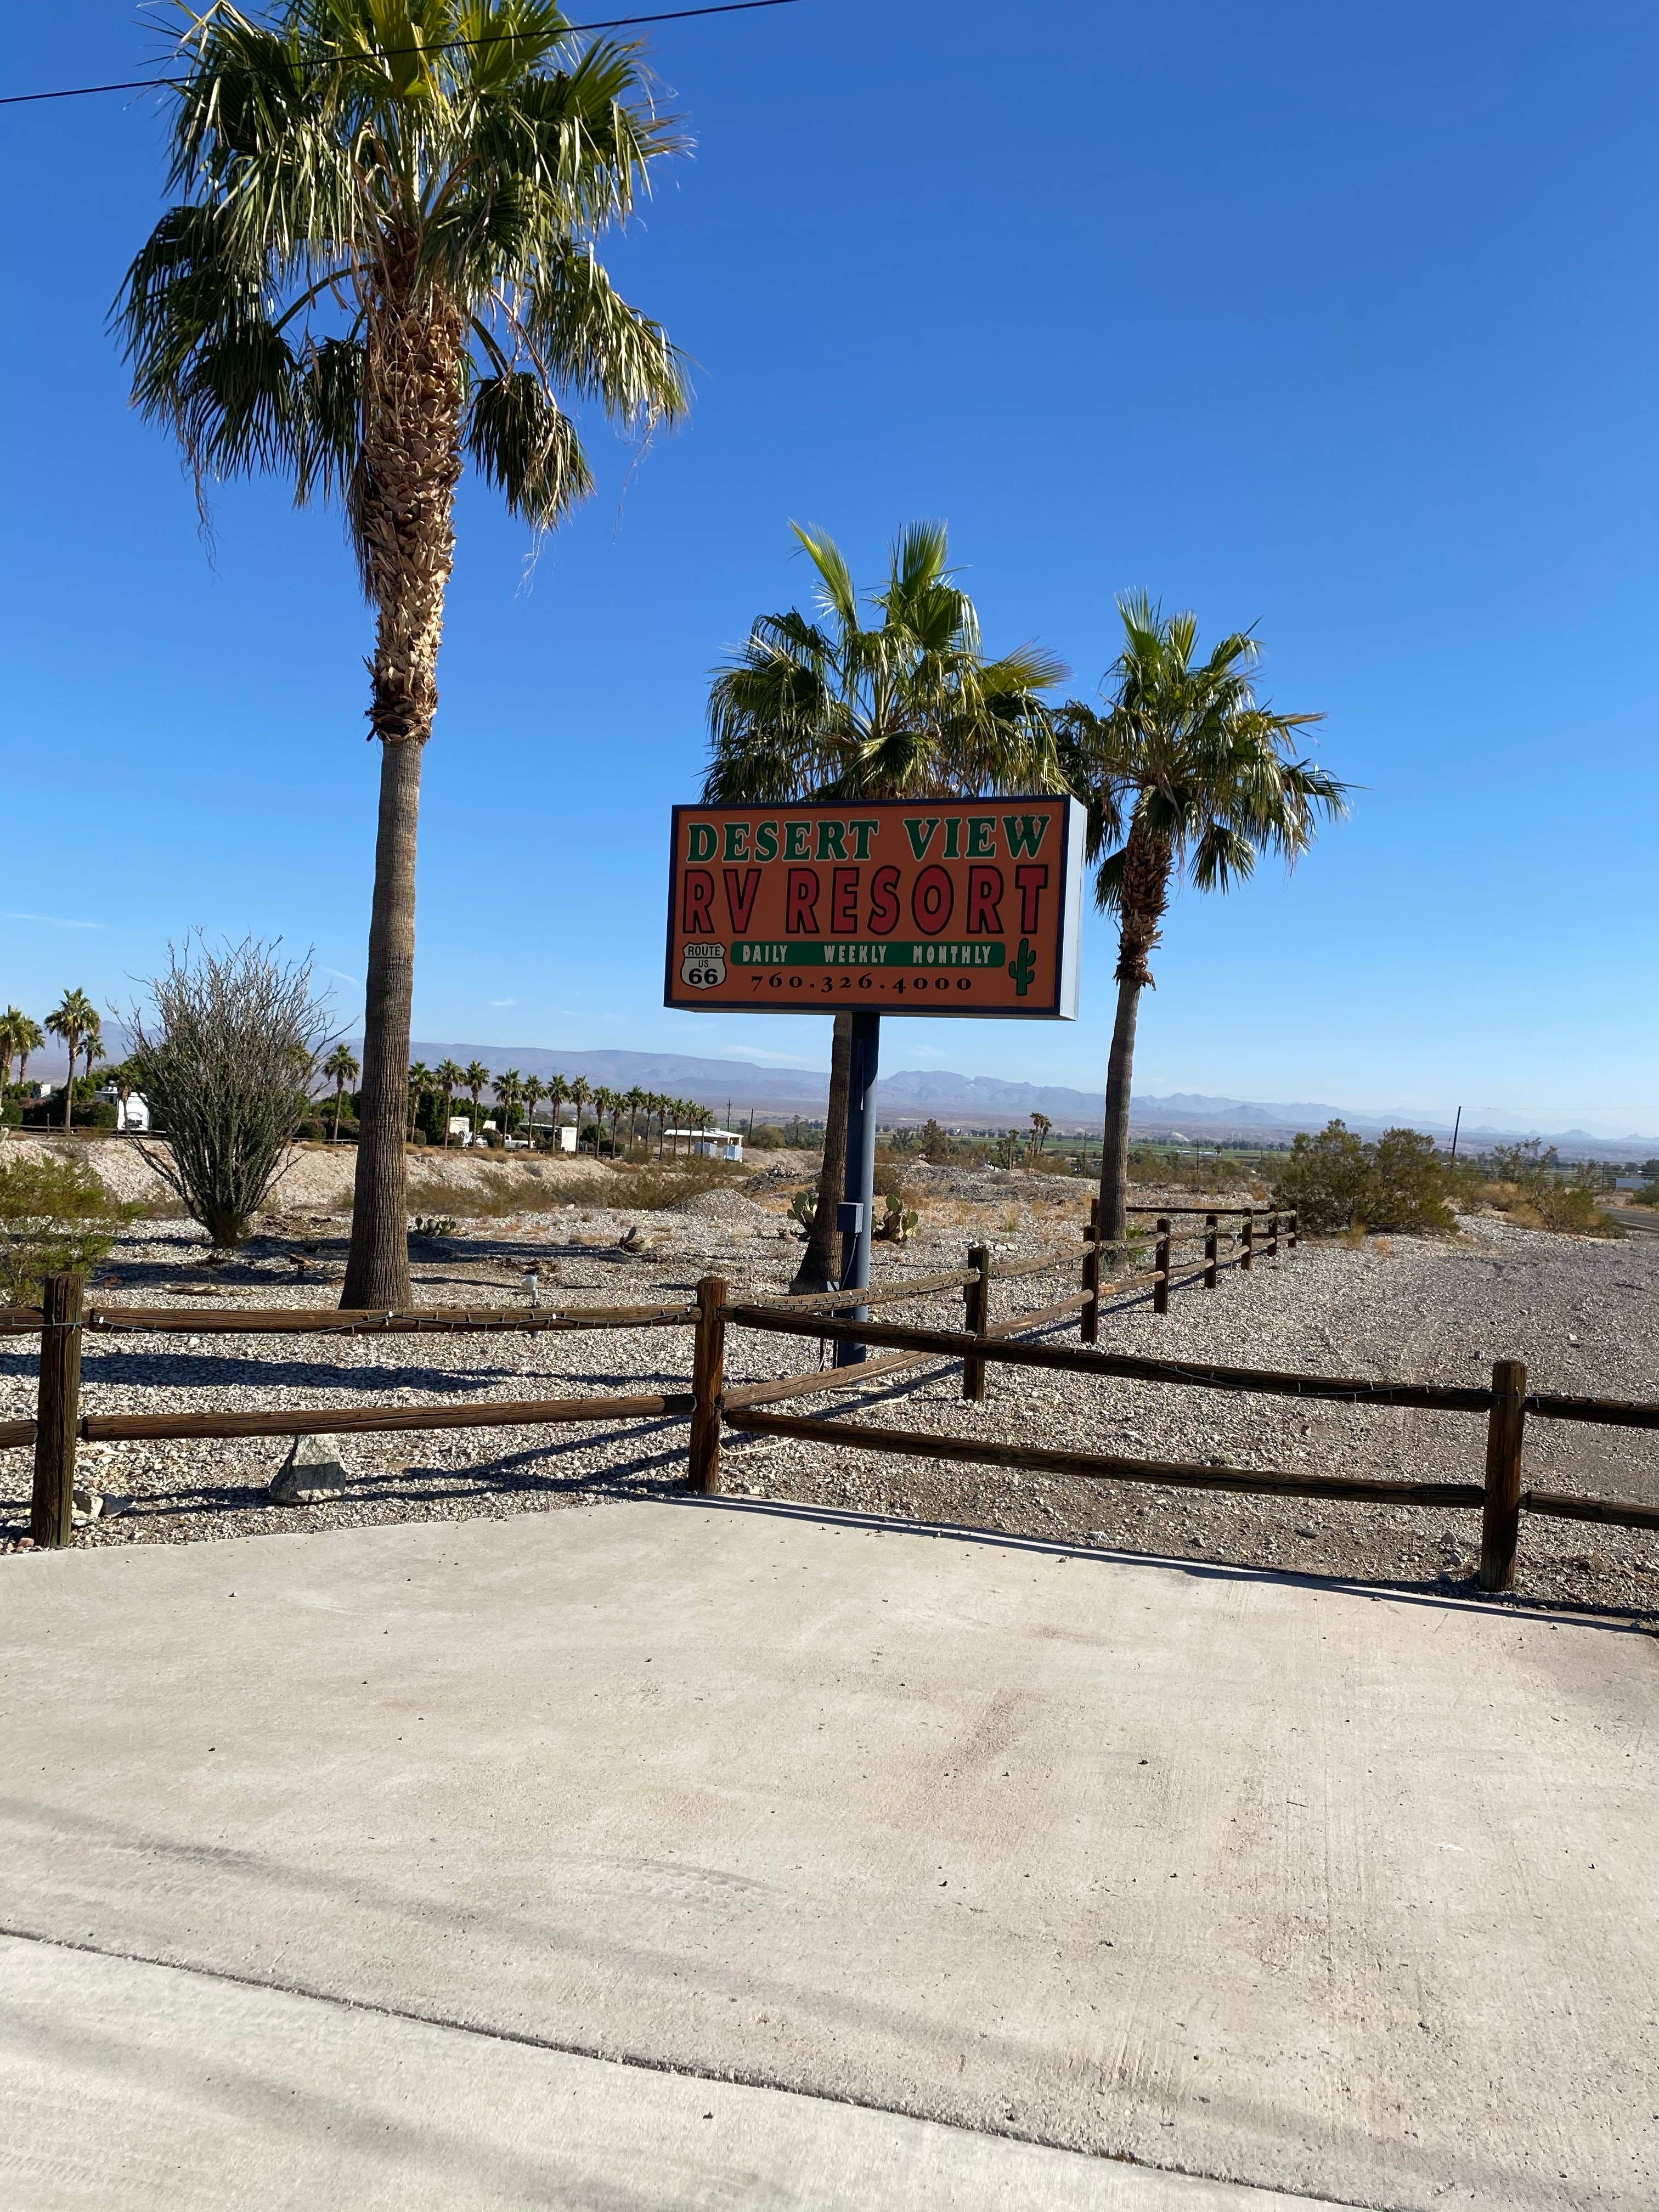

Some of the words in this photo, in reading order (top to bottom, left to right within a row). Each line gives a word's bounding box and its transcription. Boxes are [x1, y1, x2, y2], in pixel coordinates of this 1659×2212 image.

[686, 820, 879, 863] DESERT
[903, 815, 1051, 861] VIEW
[683, 868, 762, 934] RV
[786, 865, 1048, 935] RESORT
[688, 946, 720, 956] ROUTE
[743, 945, 788, 963] DAILY
[824, 945, 887, 963] WEEKLY
[913, 945, 991, 964] MONTHLY
[698, 960, 709, 968] US
[689, 968, 718, 985] 66
[751, 972, 972, 994] 760.326.4000
